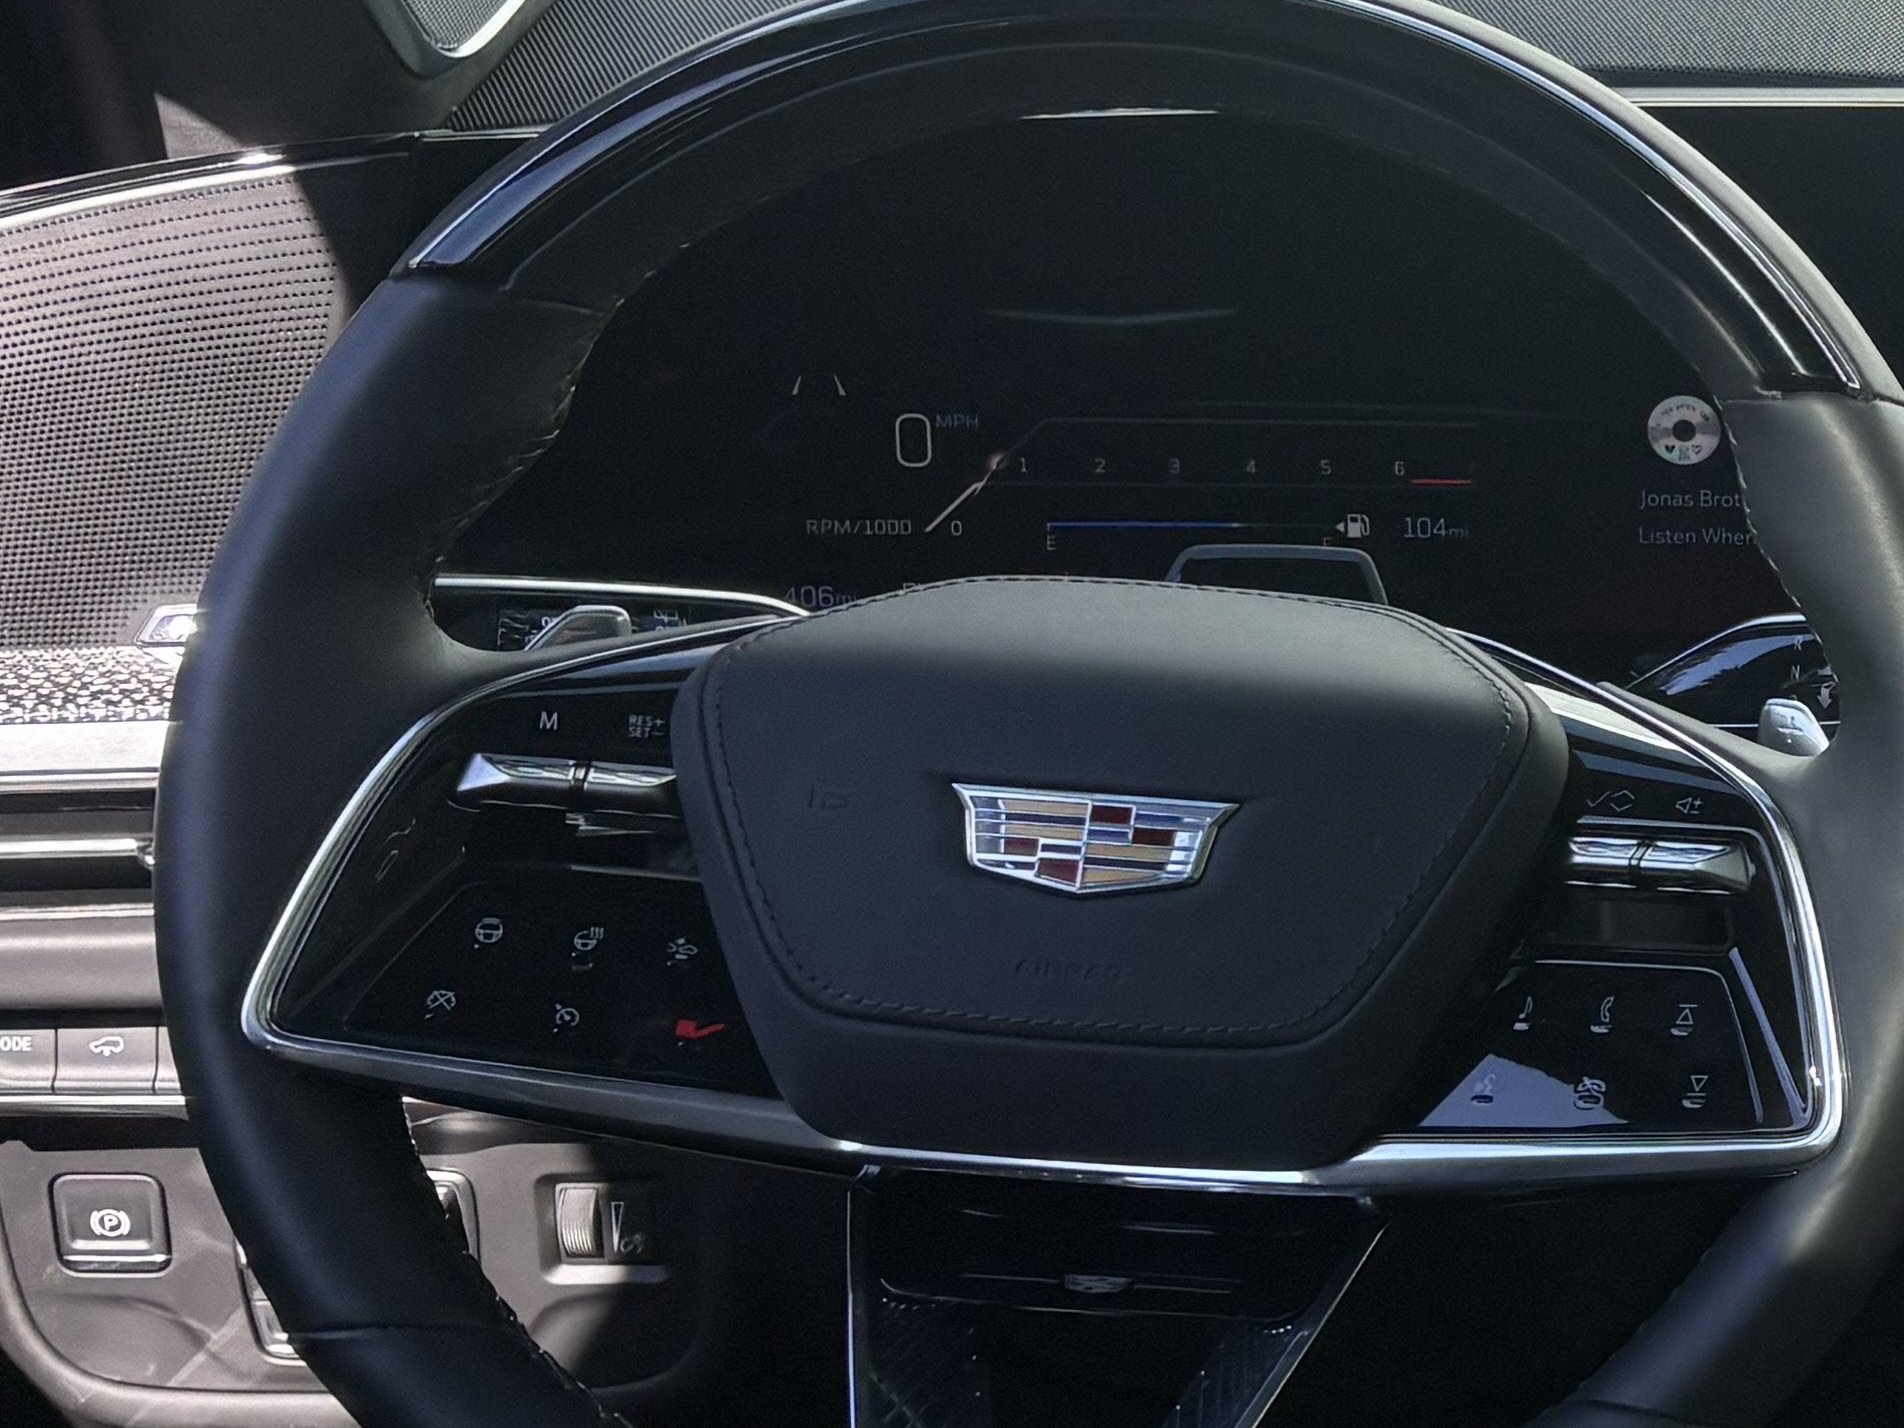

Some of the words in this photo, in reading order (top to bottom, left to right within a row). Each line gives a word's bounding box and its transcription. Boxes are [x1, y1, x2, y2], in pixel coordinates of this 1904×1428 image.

[895, 413, 934, 469] 0
[935, 414, 980, 431] MPH
[1019, 456, 1028, 473] 1
[1094, 458, 1107, 474] 2
[1169, 458, 1182, 474] 3
[1245, 459, 1258, 474] 4
[1320, 458, 1333, 475] 5
[1393, 460, 1406, 476] 6
[1638, 488, 1695, 511] Jonas
[805, 518, 913, 537] RPM/1000
[950, 519, 964, 537] 0
[1638, 525, 1698, 544] Listen
[1045, 535, 1057, 551] E
[538, 710, 560, 733] M
